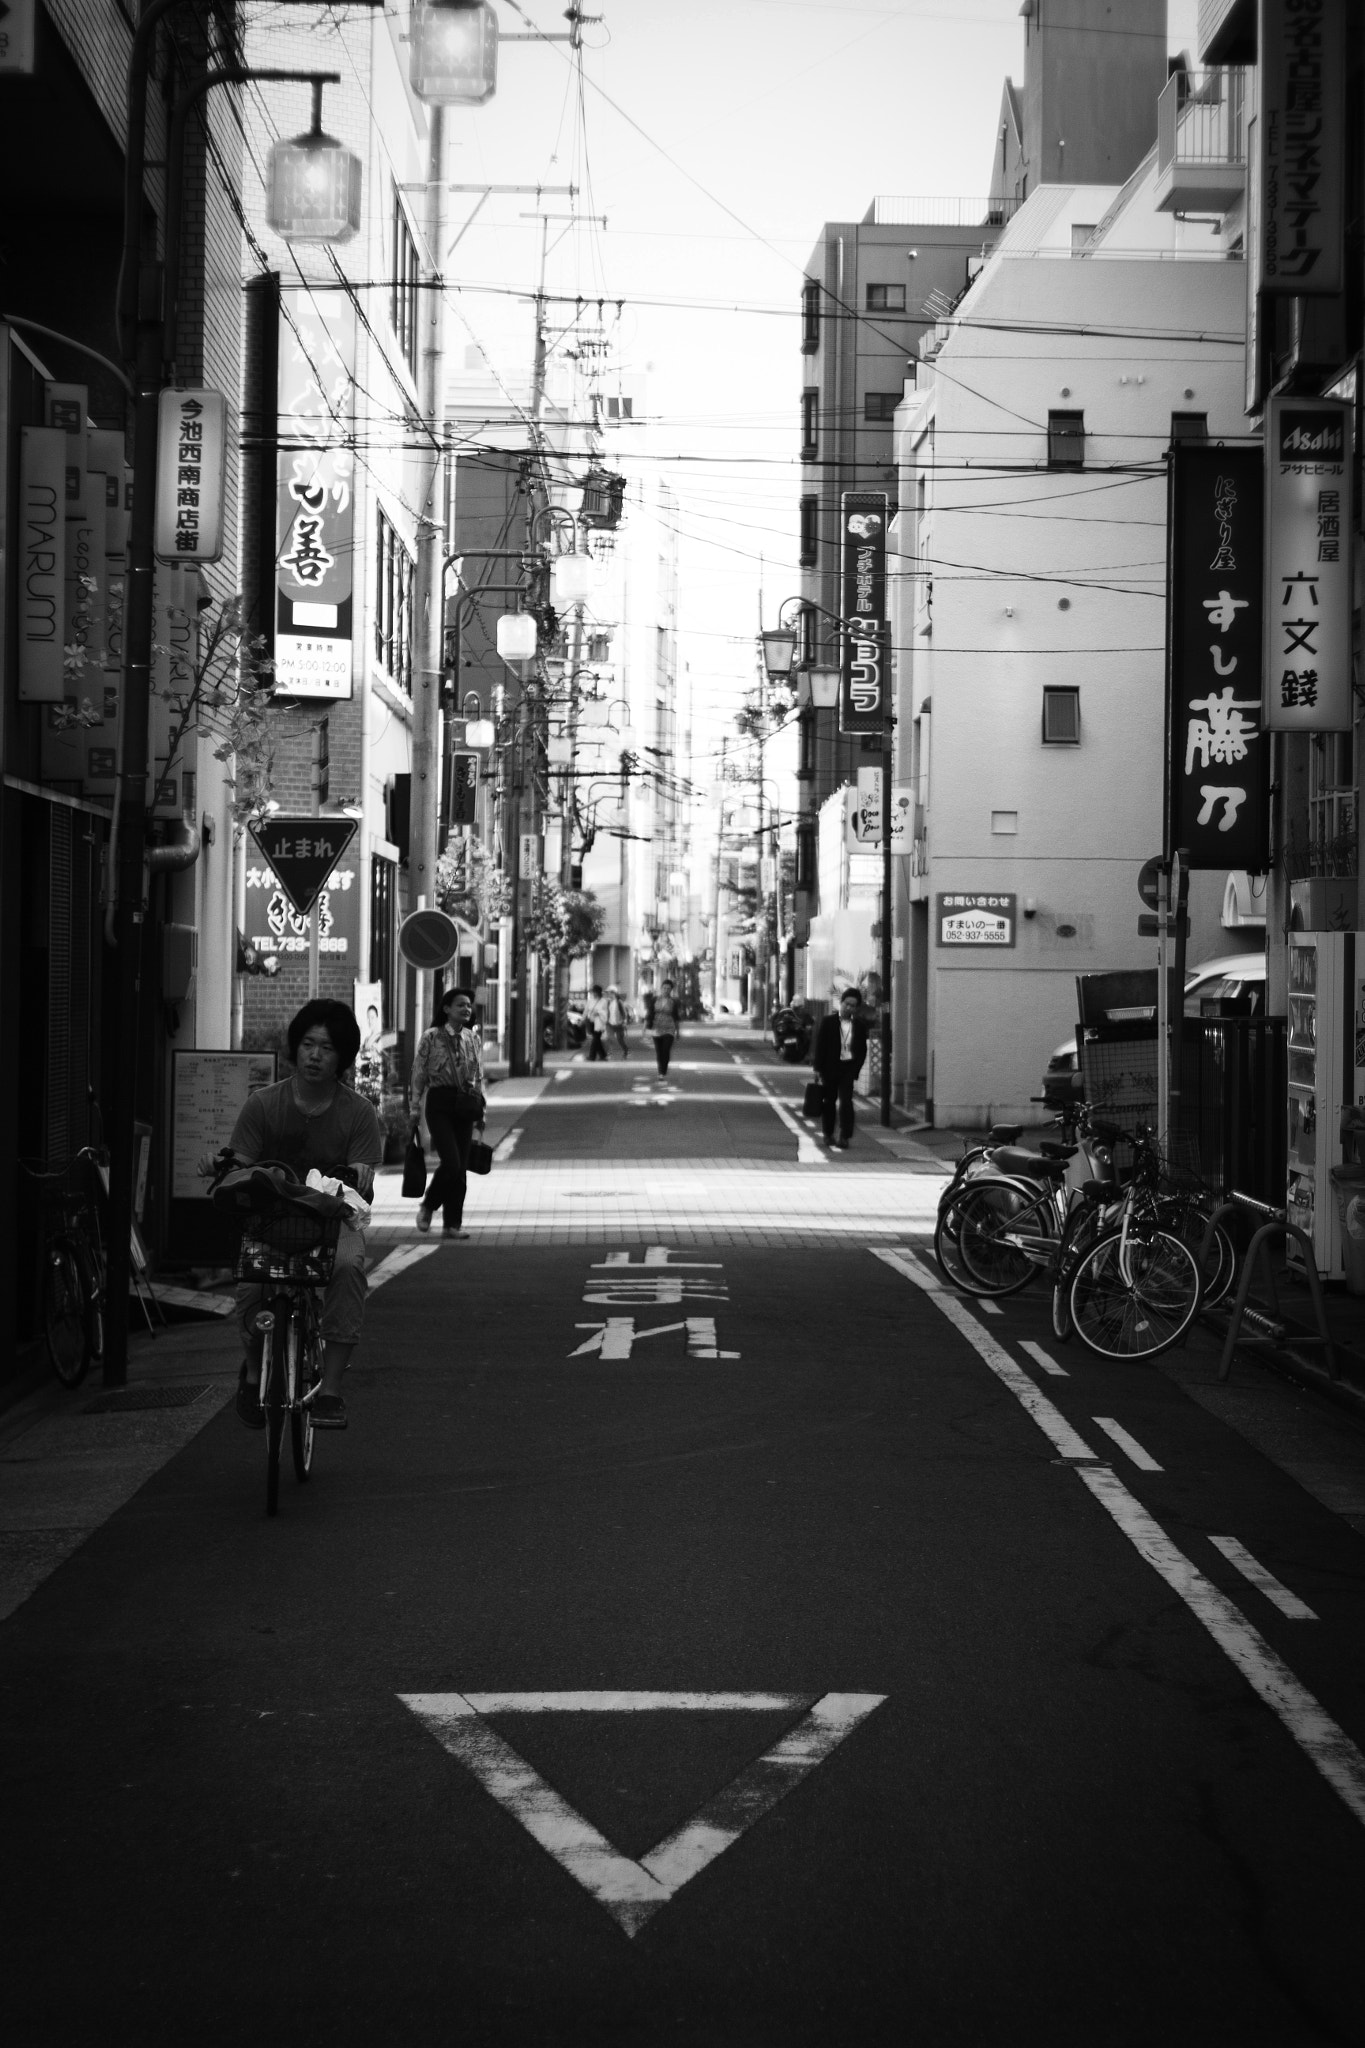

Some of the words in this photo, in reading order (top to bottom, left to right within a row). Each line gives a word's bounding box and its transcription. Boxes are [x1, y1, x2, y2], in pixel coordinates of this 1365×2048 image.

[1282, 426, 1343, 451] Asahi
[175, 398, 204, 552] 今池西南商店街
[1280, 464, 1344, 475] アサヒビール
[1210, 476, 1237, 571] にぎり屋
[1317, 490, 1341, 562] 居酒屋
[26, 485, 57, 642] MARUMI
[281, 659, 295, 670] PM
[272, 837, 334, 858] 止まれ
[943, 896, 1010, 907] お問い合わせ
[566, 1246, 741, 1359] 止まれ
